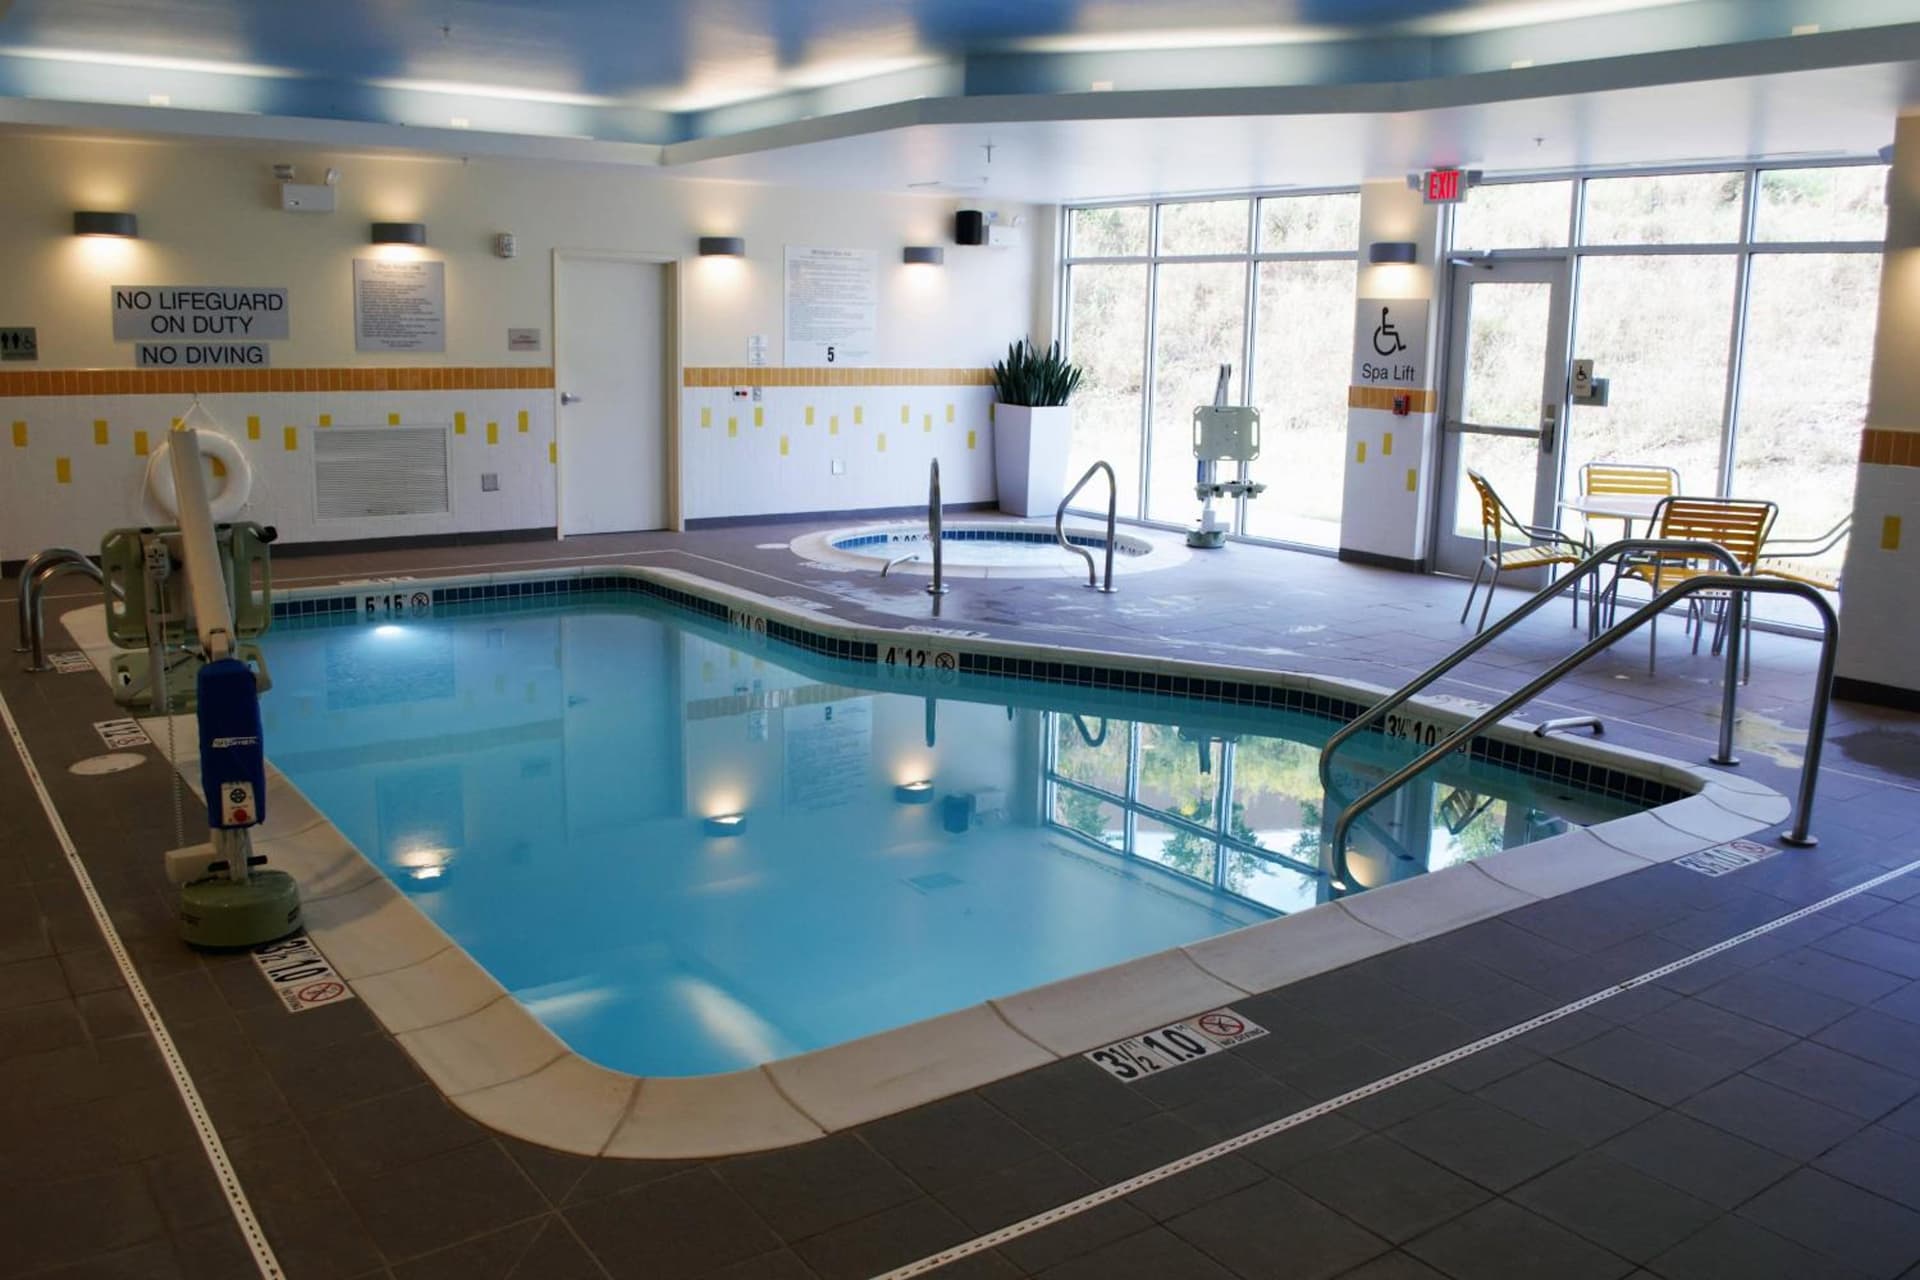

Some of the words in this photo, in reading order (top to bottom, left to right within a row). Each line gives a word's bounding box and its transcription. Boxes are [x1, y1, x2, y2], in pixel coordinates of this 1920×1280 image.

[1429, 170, 1459, 200] EXIT
[117, 291, 152, 310] NO
[159, 292, 284, 311] LIFEGUARD
[151, 315, 185, 334] ON
[193, 315, 253, 334] DUTY
[142, 346, 177, 364] NO
[186, 346, 263, 364] DIVING
[827, 346, 835, 362] 5
[1362, 363, 1388, 383] Spa
[1394, 364, 1415, 381] Lift
[886, 646, 896, 665] 4
